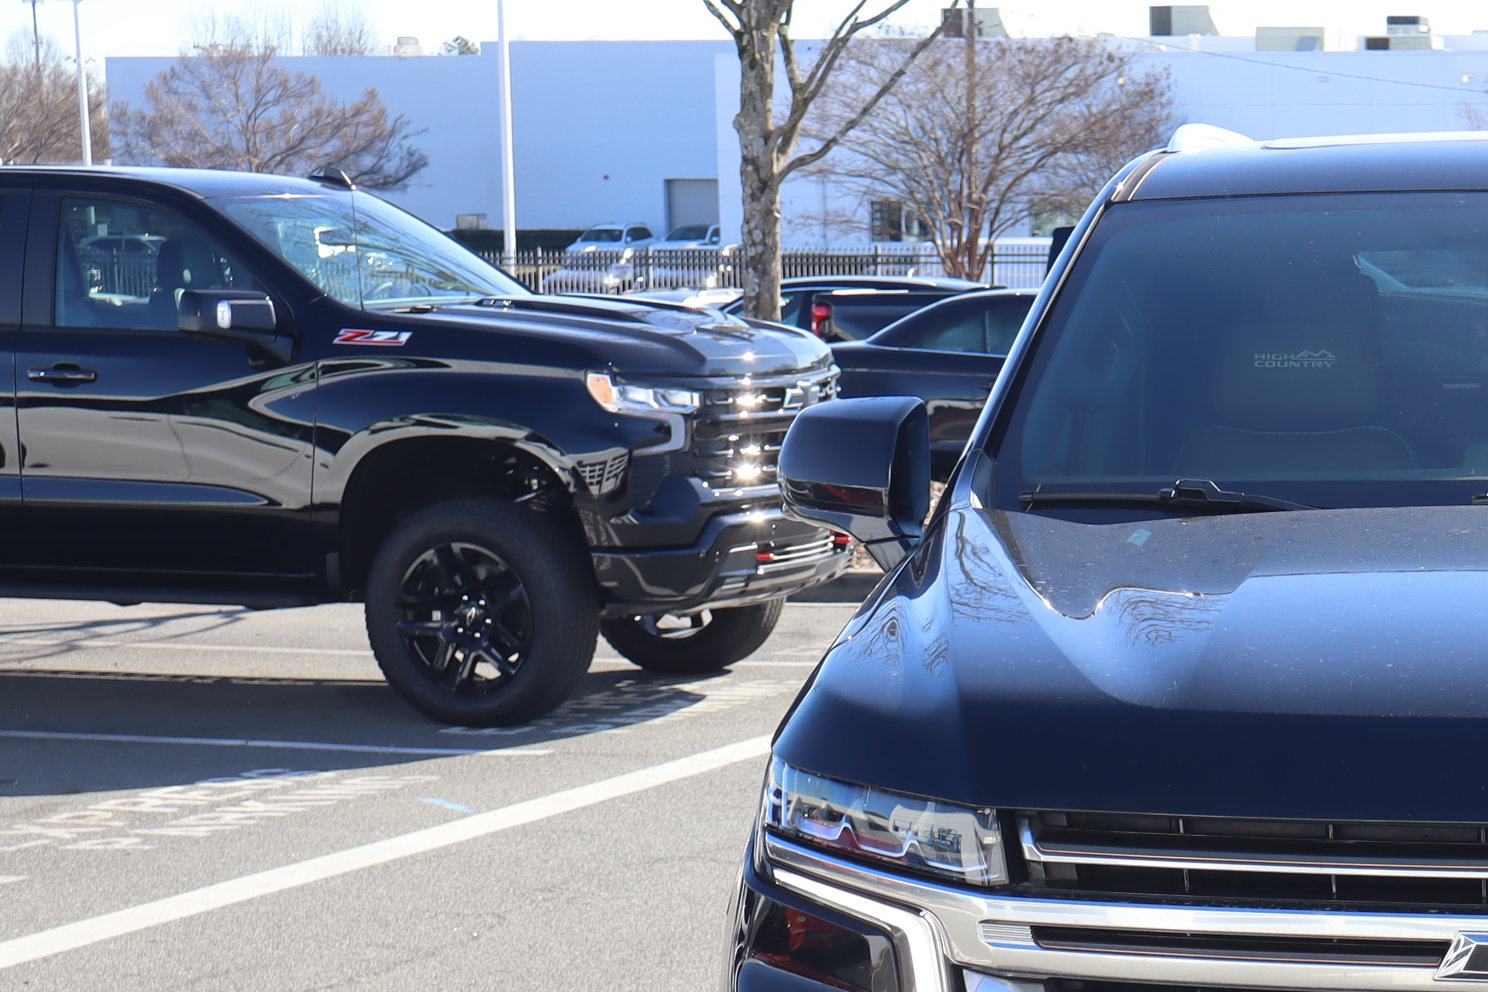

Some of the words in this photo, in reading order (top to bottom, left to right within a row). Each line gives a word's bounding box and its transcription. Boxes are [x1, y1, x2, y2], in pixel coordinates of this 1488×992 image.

[333, 328, 413, 346] Z71
[1254, 360, 1336, 368] COUNTRY
[59, 774, 441, 851] PARKING
